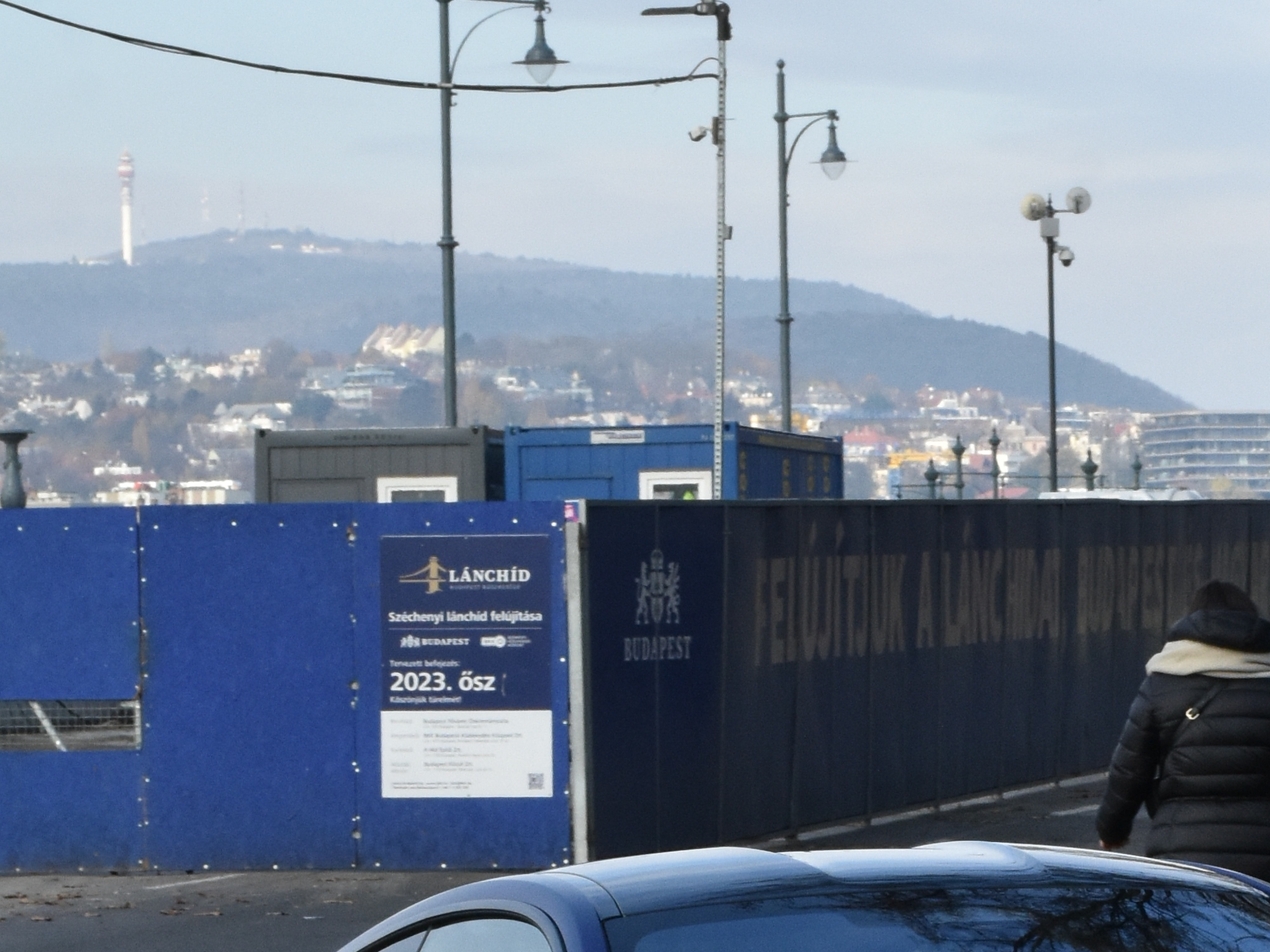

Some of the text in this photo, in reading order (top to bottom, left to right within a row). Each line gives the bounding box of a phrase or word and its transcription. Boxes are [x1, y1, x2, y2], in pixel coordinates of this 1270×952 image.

[449, 566, 531, 583] LÁNCHÍD
[917, 550, 934, 649] A
[388, 610, 543, 625] Széchenyi lánchíd felújítása
[421, 637, 470, 646] BUDAPEST
[624, 635, 692, 662] BUDAPEST
[390, 670, 496, 691] 2023. ősz
